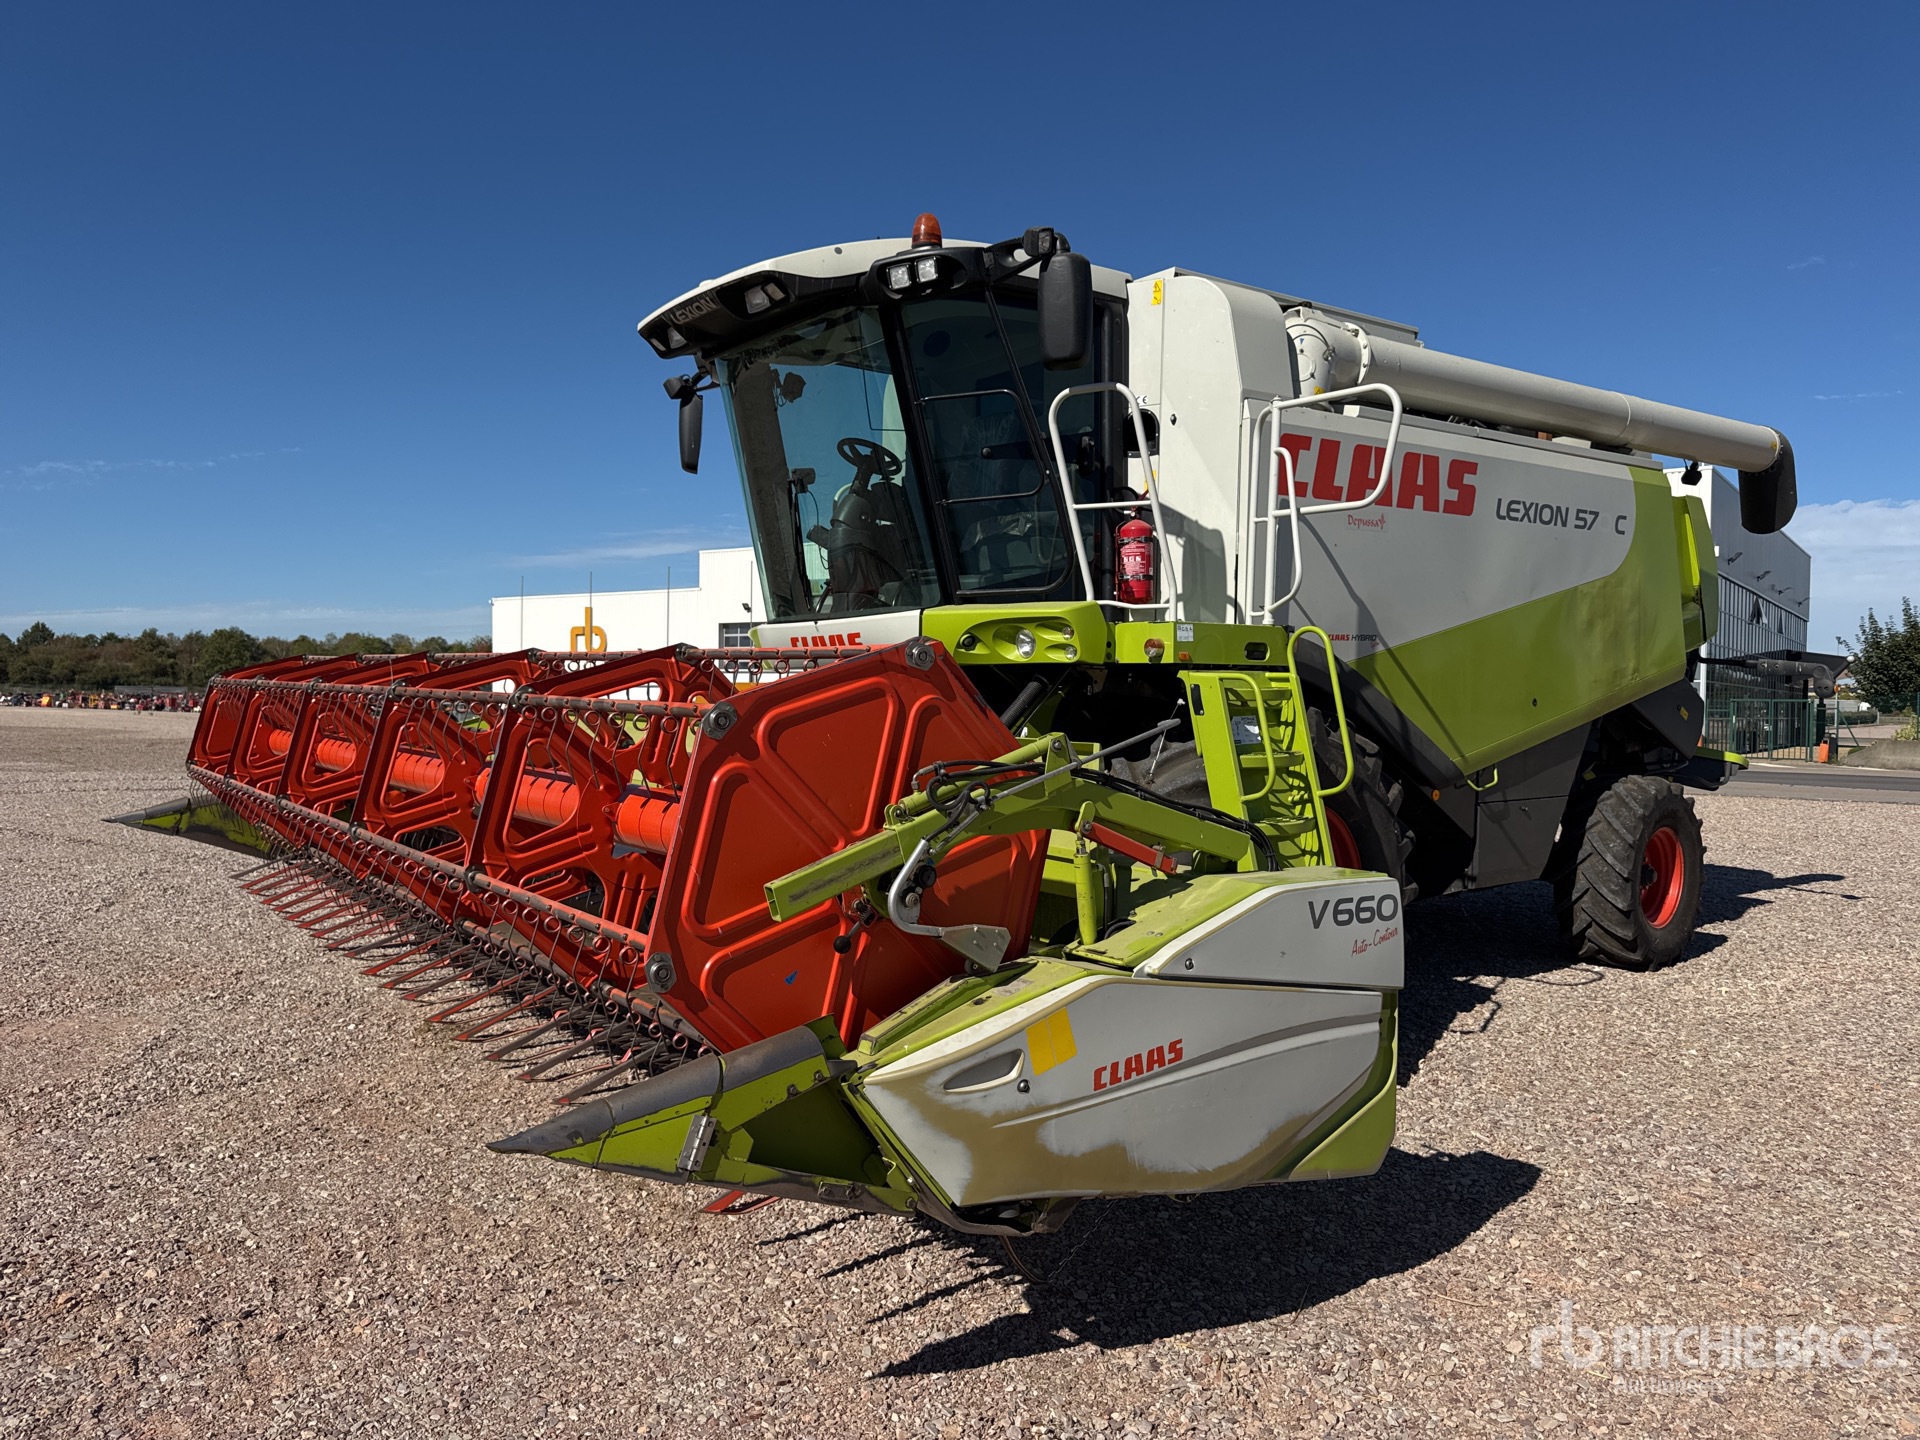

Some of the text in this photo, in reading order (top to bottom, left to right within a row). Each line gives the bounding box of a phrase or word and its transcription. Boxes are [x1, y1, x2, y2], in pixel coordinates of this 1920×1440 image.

[670, 296, 717, 325] LEXION
[1279, 433, 1479, 516] CLAAS
[1495, 498, 1570, 528] LEXION
[1351, 634, 1377, 642] HYBRID
[1093, 1038, 1184, 1092] CLAAS
